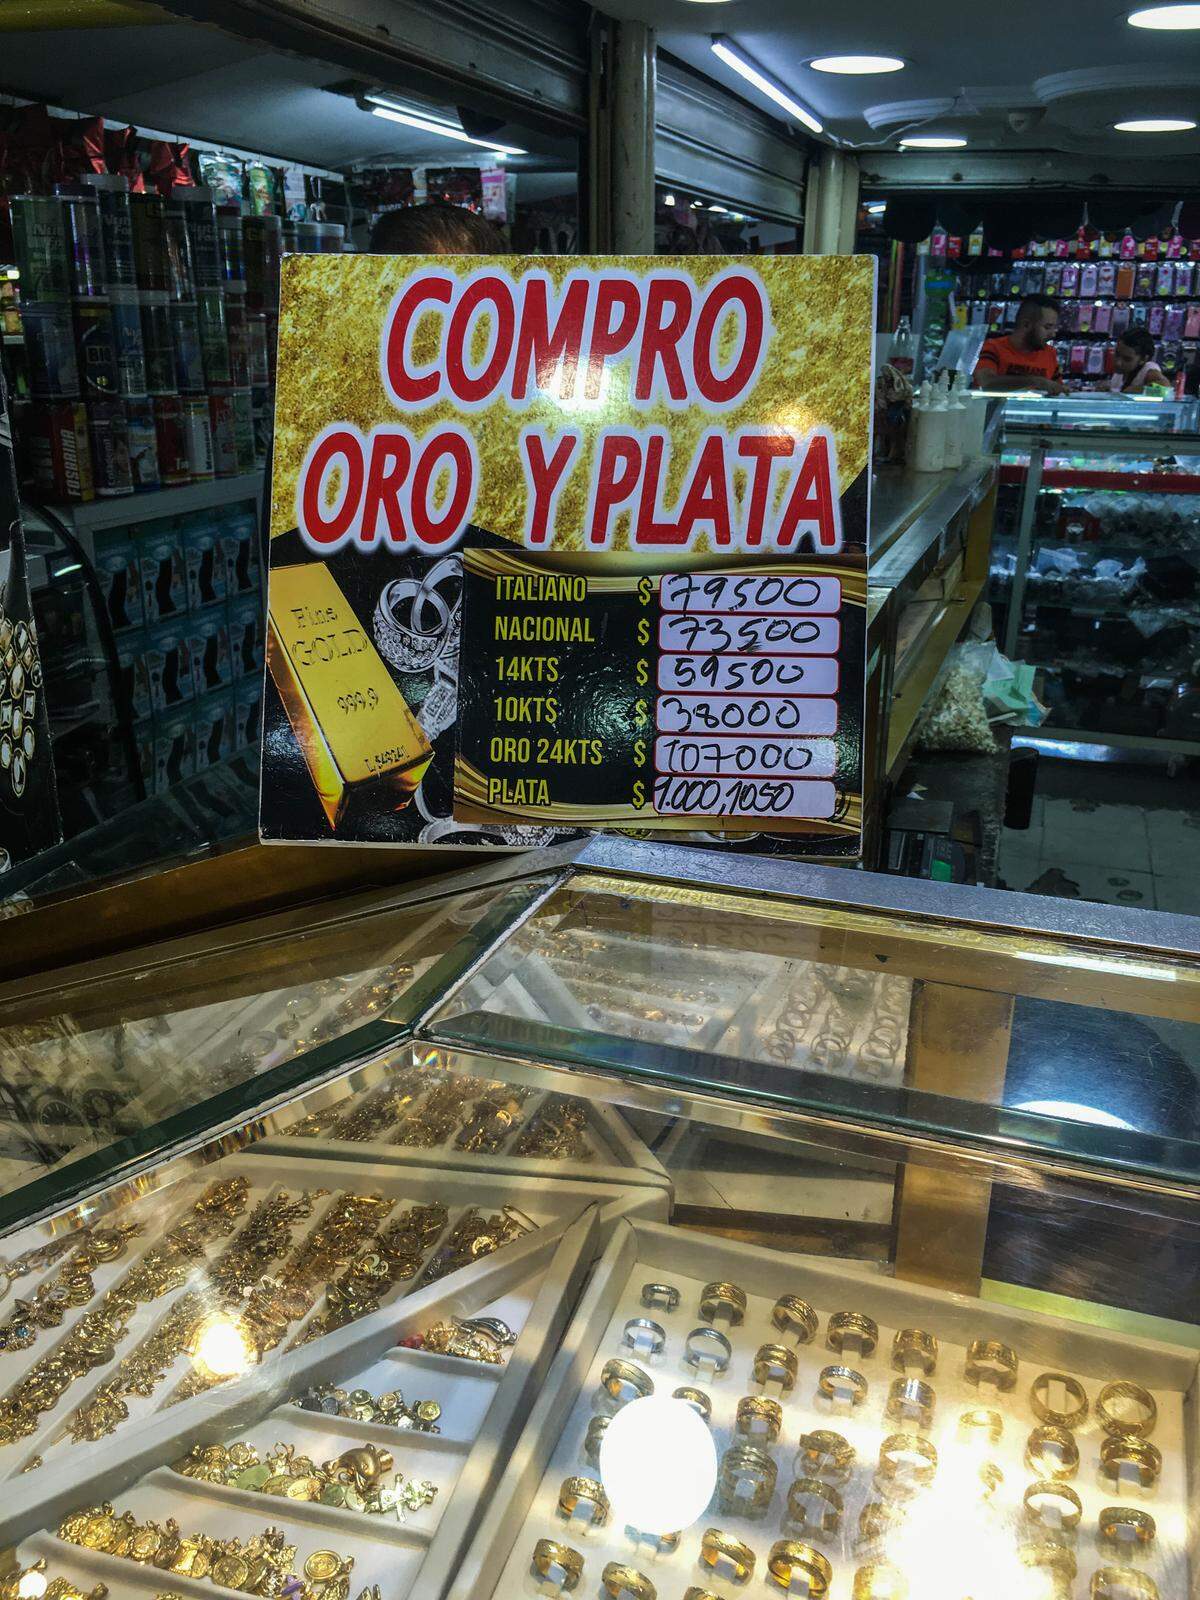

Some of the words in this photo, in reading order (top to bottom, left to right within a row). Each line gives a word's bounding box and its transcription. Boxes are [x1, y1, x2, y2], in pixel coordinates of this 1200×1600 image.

[385, 272, 767, 404] COMPRO
[301, 430, 474, 545] ORO
[525, 434, 577, 543] Y
[590, 434, 837, 547] PLATA
[495, 575, 587, 602] ITALIANO
[638, 578, 651, 606] $
[667, 573, 821, 615] 79500
[291, 629, 368, 666] GOLD
[494, 616, 595, 642] NACIONAL
[637, 618, 650, 646] $
[668, 616, 821, 652] 73500
[495, 656, 559, 683] 14KTS
[636, 658, 649, 686] $
[674, 655, 805, 691] 59500
[493, 696, 558, 724] 10KTS
[635, 698, 648, 727] $
[661, 697, 801, 733] 38000
[489, 737, 531, 764] ORO
[536, 738, 603, 766] 24KTS
[633, 739, 646, 768] $
[663, 739, 813, 773] 107000
[488, 777, 550, 804] PLATA
[631, 780, 645, 809] $
